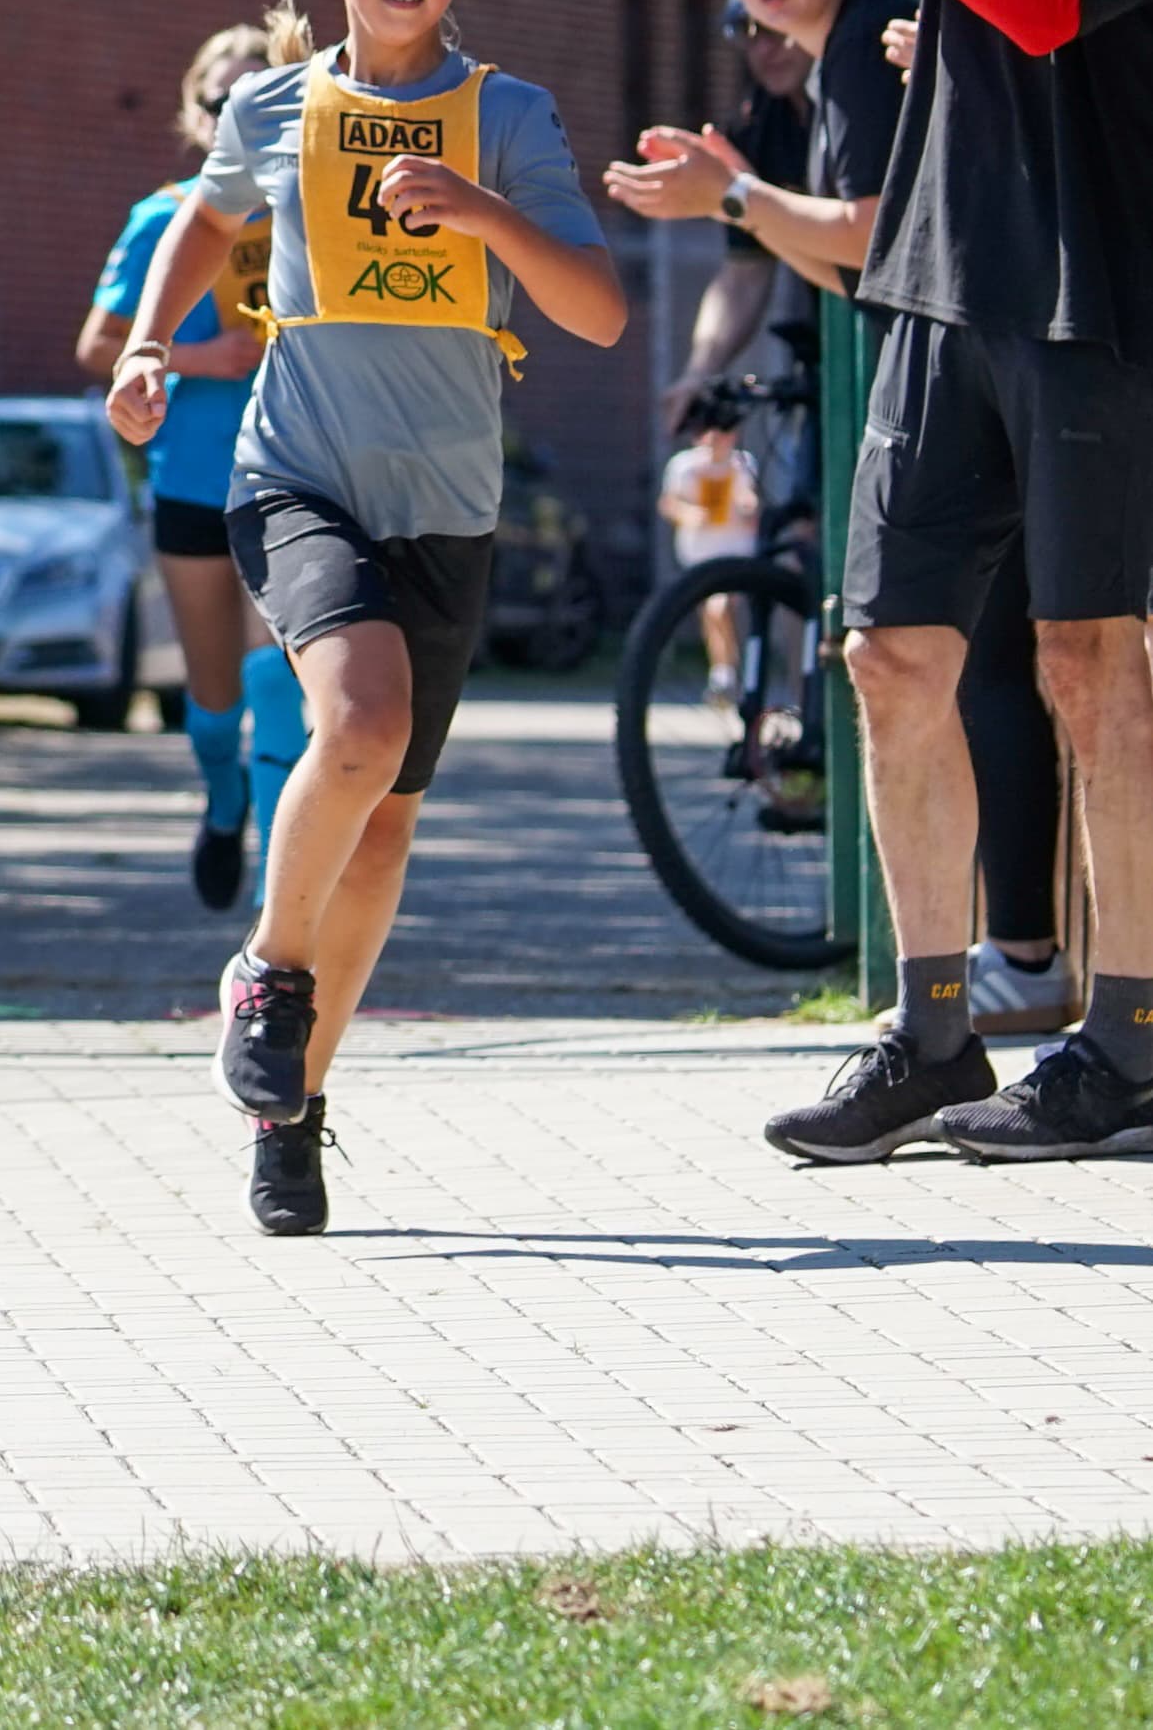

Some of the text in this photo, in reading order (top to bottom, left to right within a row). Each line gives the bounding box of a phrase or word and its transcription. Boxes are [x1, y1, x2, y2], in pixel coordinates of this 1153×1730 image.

[347, 120, 432, 152] ADAC
[348, 259, 457, 304] AOK
[930, 982, 962, 999] CAT
